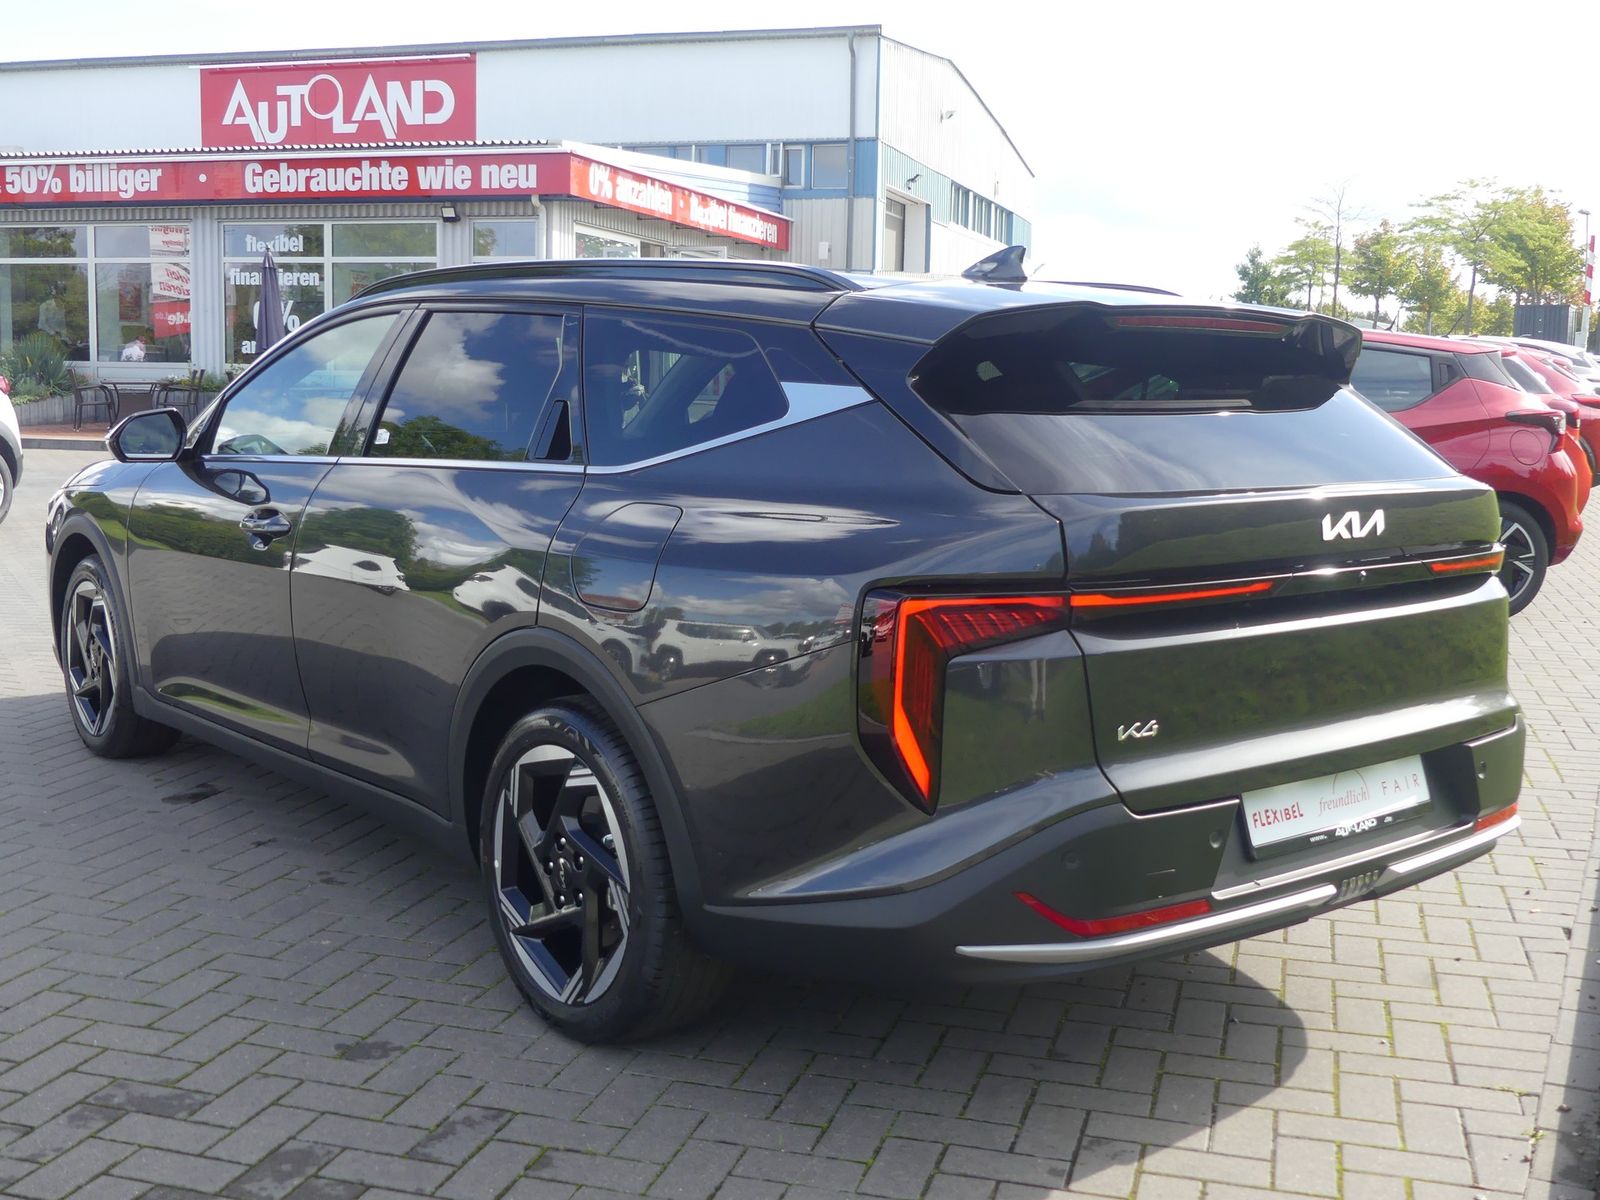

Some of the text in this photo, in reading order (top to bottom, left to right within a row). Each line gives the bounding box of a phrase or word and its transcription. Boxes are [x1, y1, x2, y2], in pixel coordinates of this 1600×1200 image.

[222, 74, 455, 144] AUTOLAND
[5, 163, 162, 198] 50% billiger
[244, 158, 537, 193] Gebrauchte wie neu
[588, 162, 673, 216] 0% anzahlen
[727, 204, 778, 244] finanzieren
[245, 234, 303, 252] flexibel
[230, 267, 320, 286] finaieren
[1322, 508, 1386, 541] KIA
[1252, 801, 1304, 828] FLEXIBEL
[1318, 786, 1367, 816] freundlich
